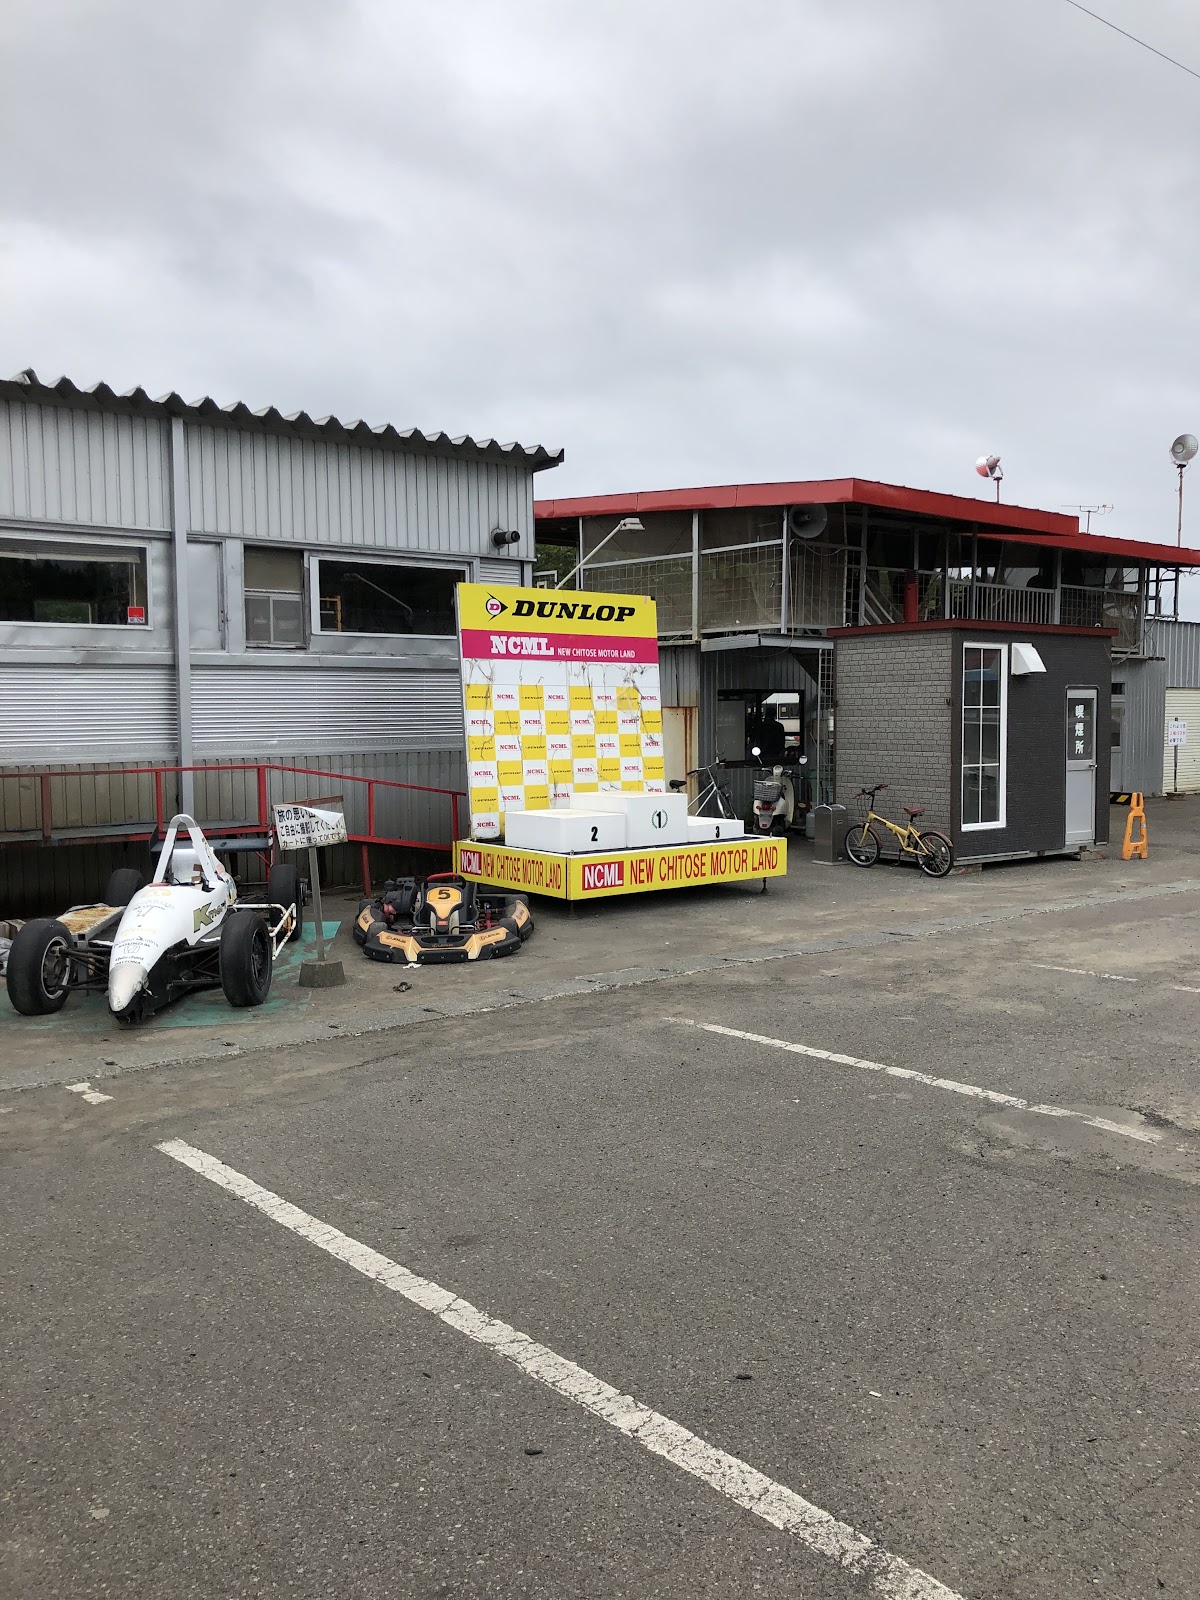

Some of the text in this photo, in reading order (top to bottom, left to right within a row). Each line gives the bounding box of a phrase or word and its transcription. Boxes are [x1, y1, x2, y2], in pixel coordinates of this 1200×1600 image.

[512, 600, 636, 622] DUNLOP
[490, 635, 635, 658] NCML NEW CHITOSE MOTOR LAND
[1075, 704, 1084, 754] 喫煙所
[656, 810, 662, 828] 1
[591, 826, 598, 842] 2
[715, 826, 720, 838] 3
[461, 850, 561, 889] NCML NEW CHITOSE MOTOR LAND
[584, 846, 778, 888] NCML NEW CHITOSE MOTOR LAND
[438, 889, 450, 900] 5
